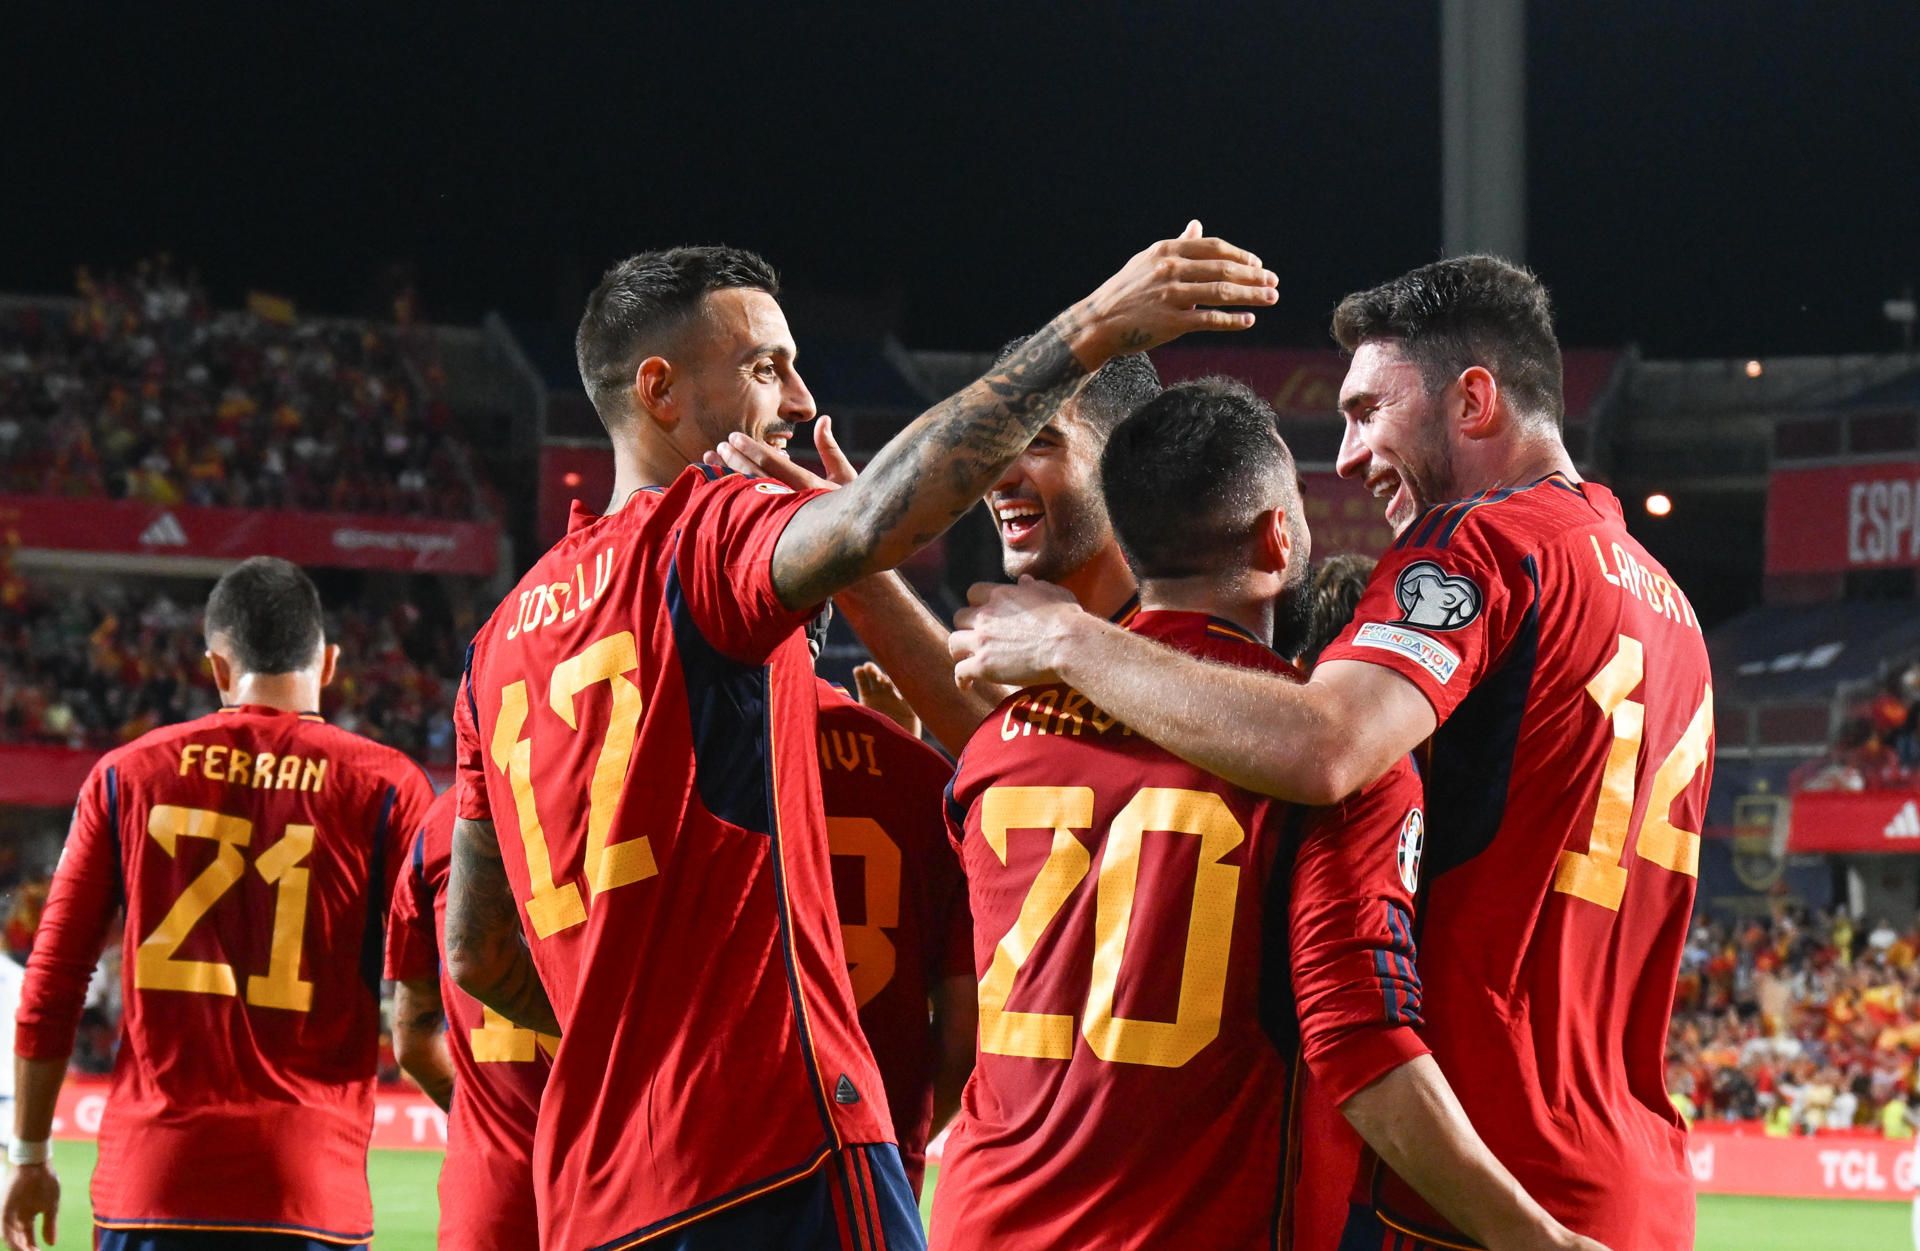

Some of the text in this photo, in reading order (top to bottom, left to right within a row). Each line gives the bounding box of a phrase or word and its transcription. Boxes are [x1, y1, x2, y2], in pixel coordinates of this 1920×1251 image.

[1849, 480, 1920, 563] ESP
[1590, 535, 1702, 635] LAPORT
[1361, 629, 1453, 674] FOUNDATION
[1001, 689, 1131, 741] CARV
[179, 744, 328, 793] FERRAN
[135, 804, 315, 1012] 21
[977, 786, 1245, 1069] 20
[1818, 1150, 1888, 1191] TCL
